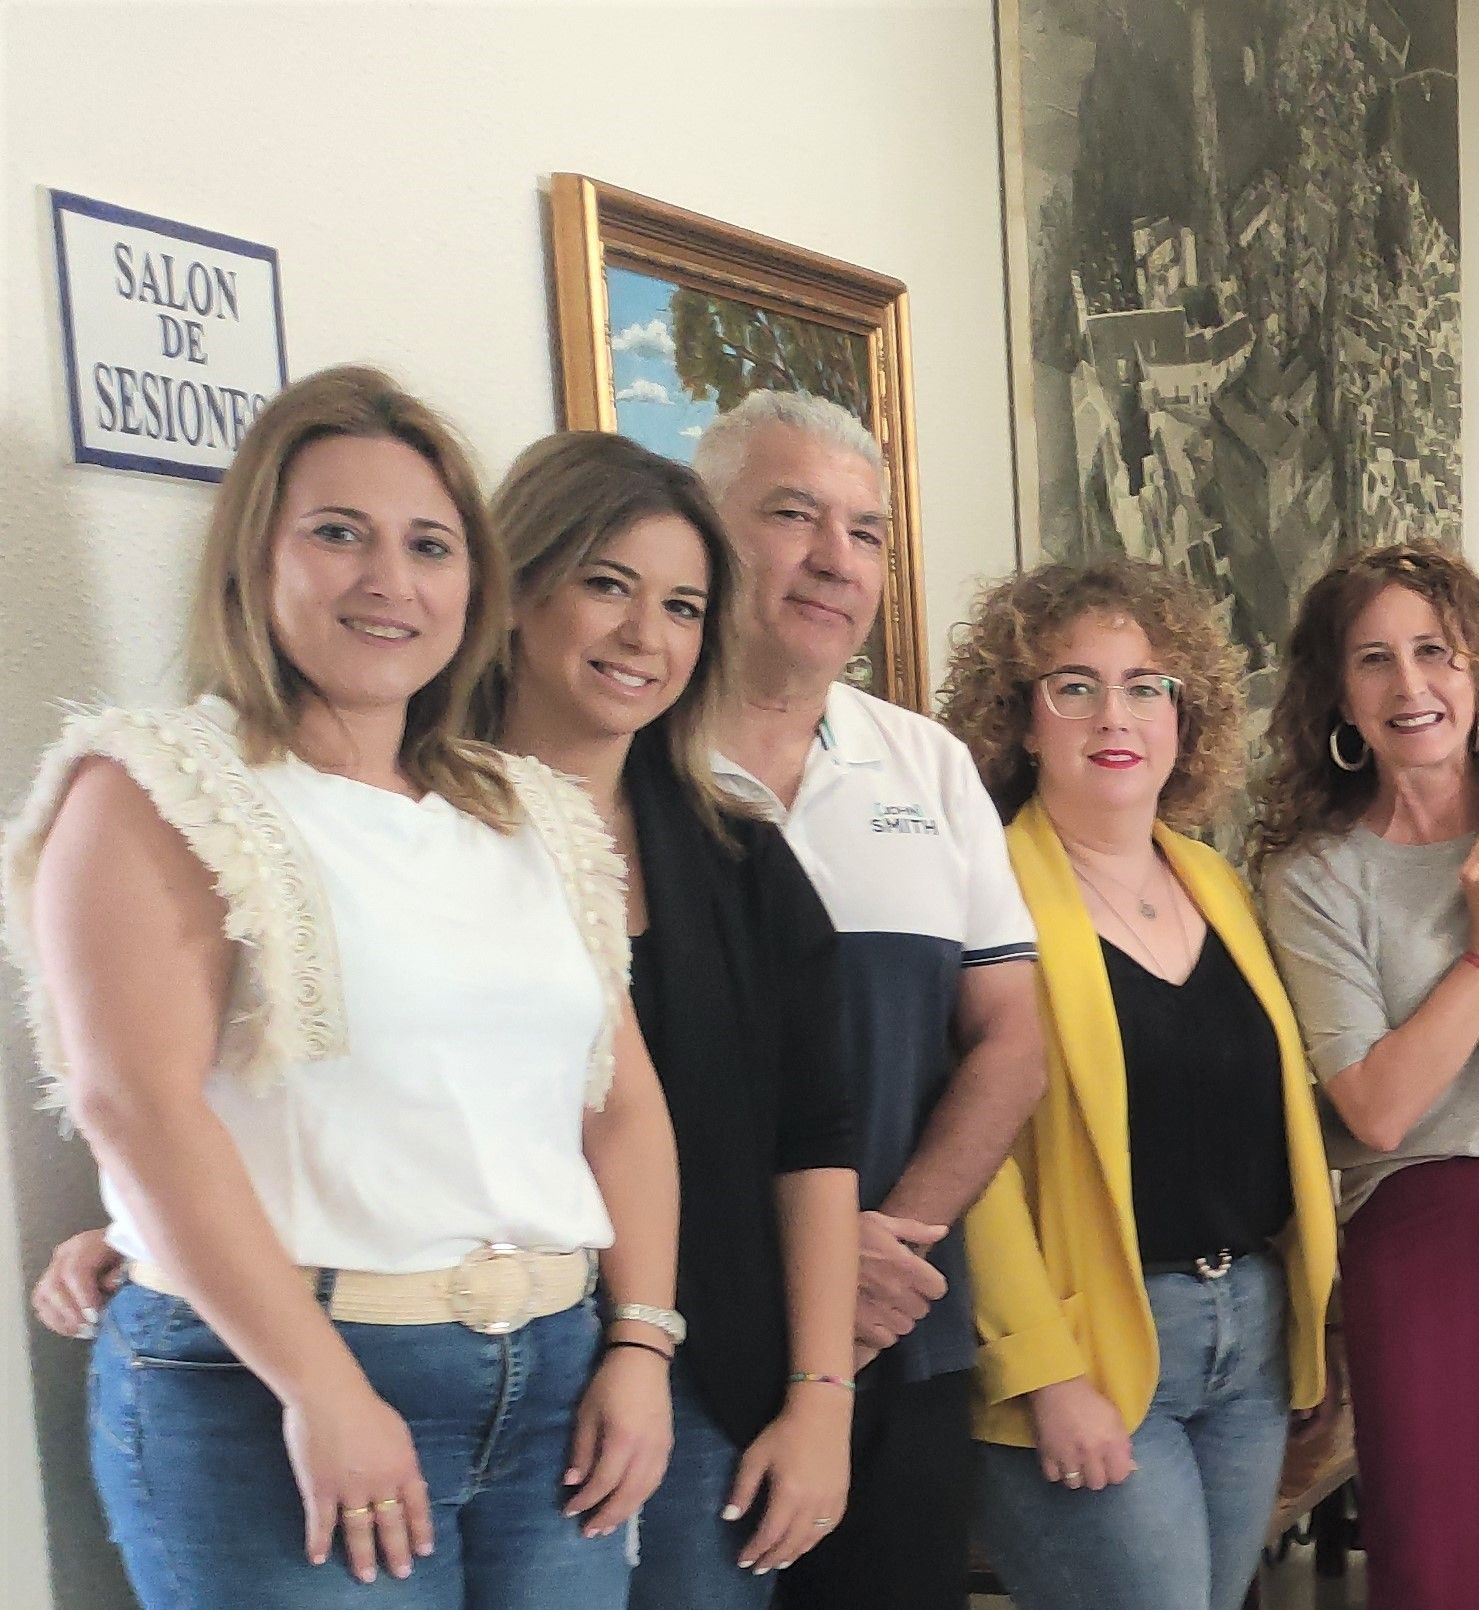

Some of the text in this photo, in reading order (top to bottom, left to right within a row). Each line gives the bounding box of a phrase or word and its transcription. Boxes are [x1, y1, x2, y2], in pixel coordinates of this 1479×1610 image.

[114, 241, 240, 322] SALON
[158, 313, 209, 366] DE
[871, 818, 940, 836] SMITH
